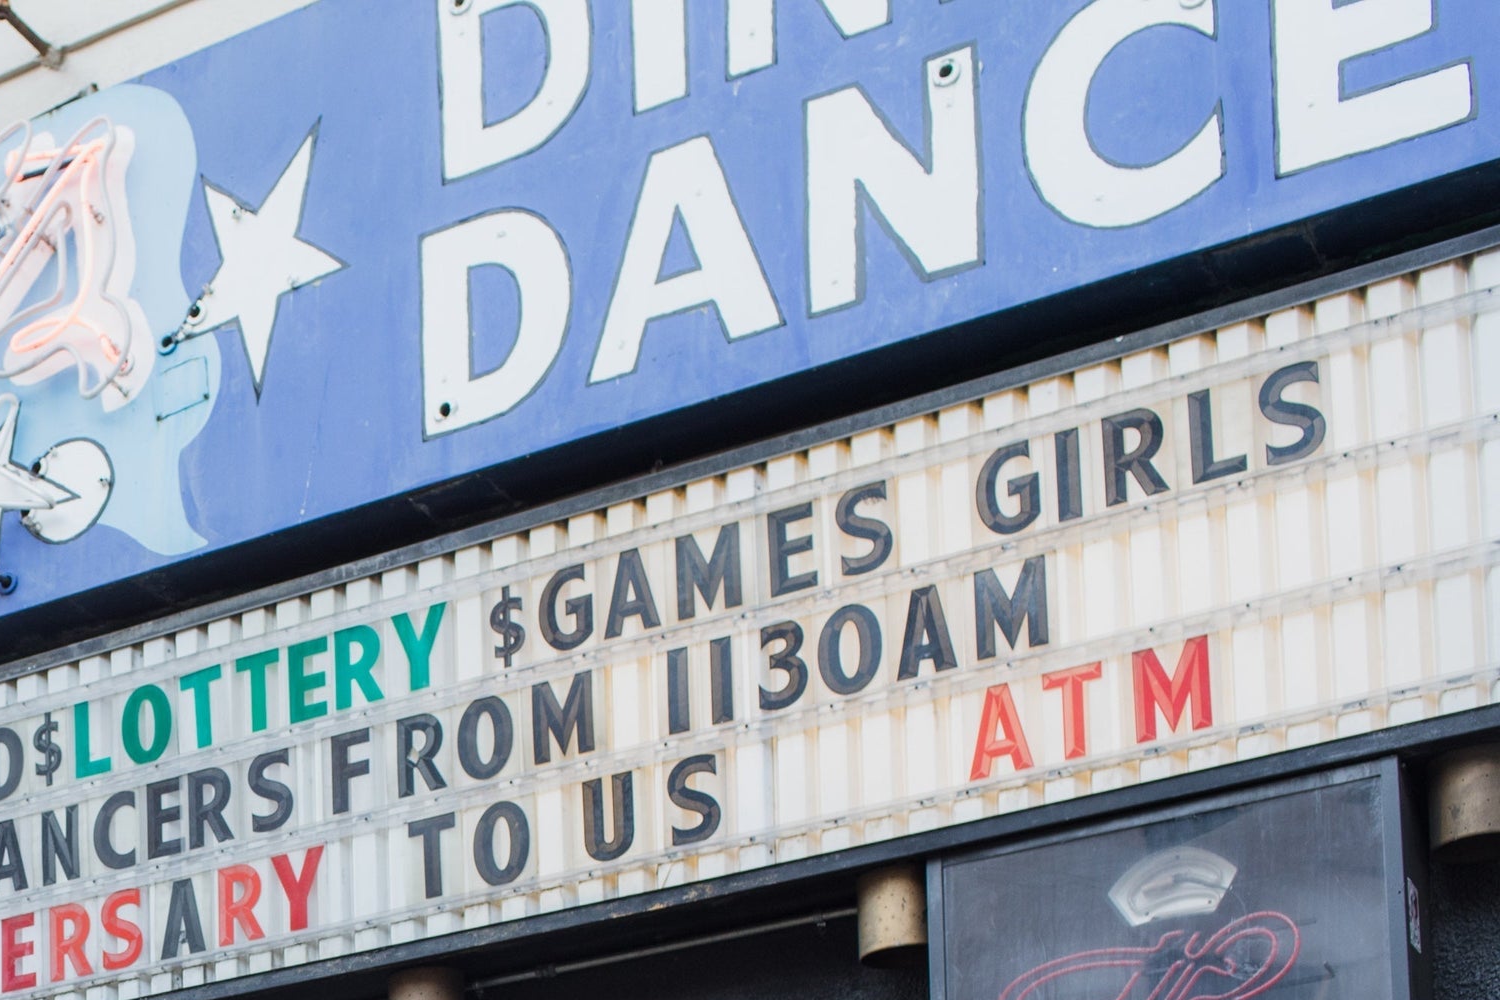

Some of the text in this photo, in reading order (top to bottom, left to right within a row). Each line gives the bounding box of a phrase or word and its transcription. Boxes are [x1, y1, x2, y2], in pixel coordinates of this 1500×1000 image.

[419, 0, 1477, 443] DANCE
[488, 480, 894, 668] $GAMES
[976, 360, 1327, 535] GIRLS
[331, 670, 596, 815] FROM
[407, 799, 530, 900] TO
[581, 752, 722, 862] US
[968, 633, 1214, 782] ATM
